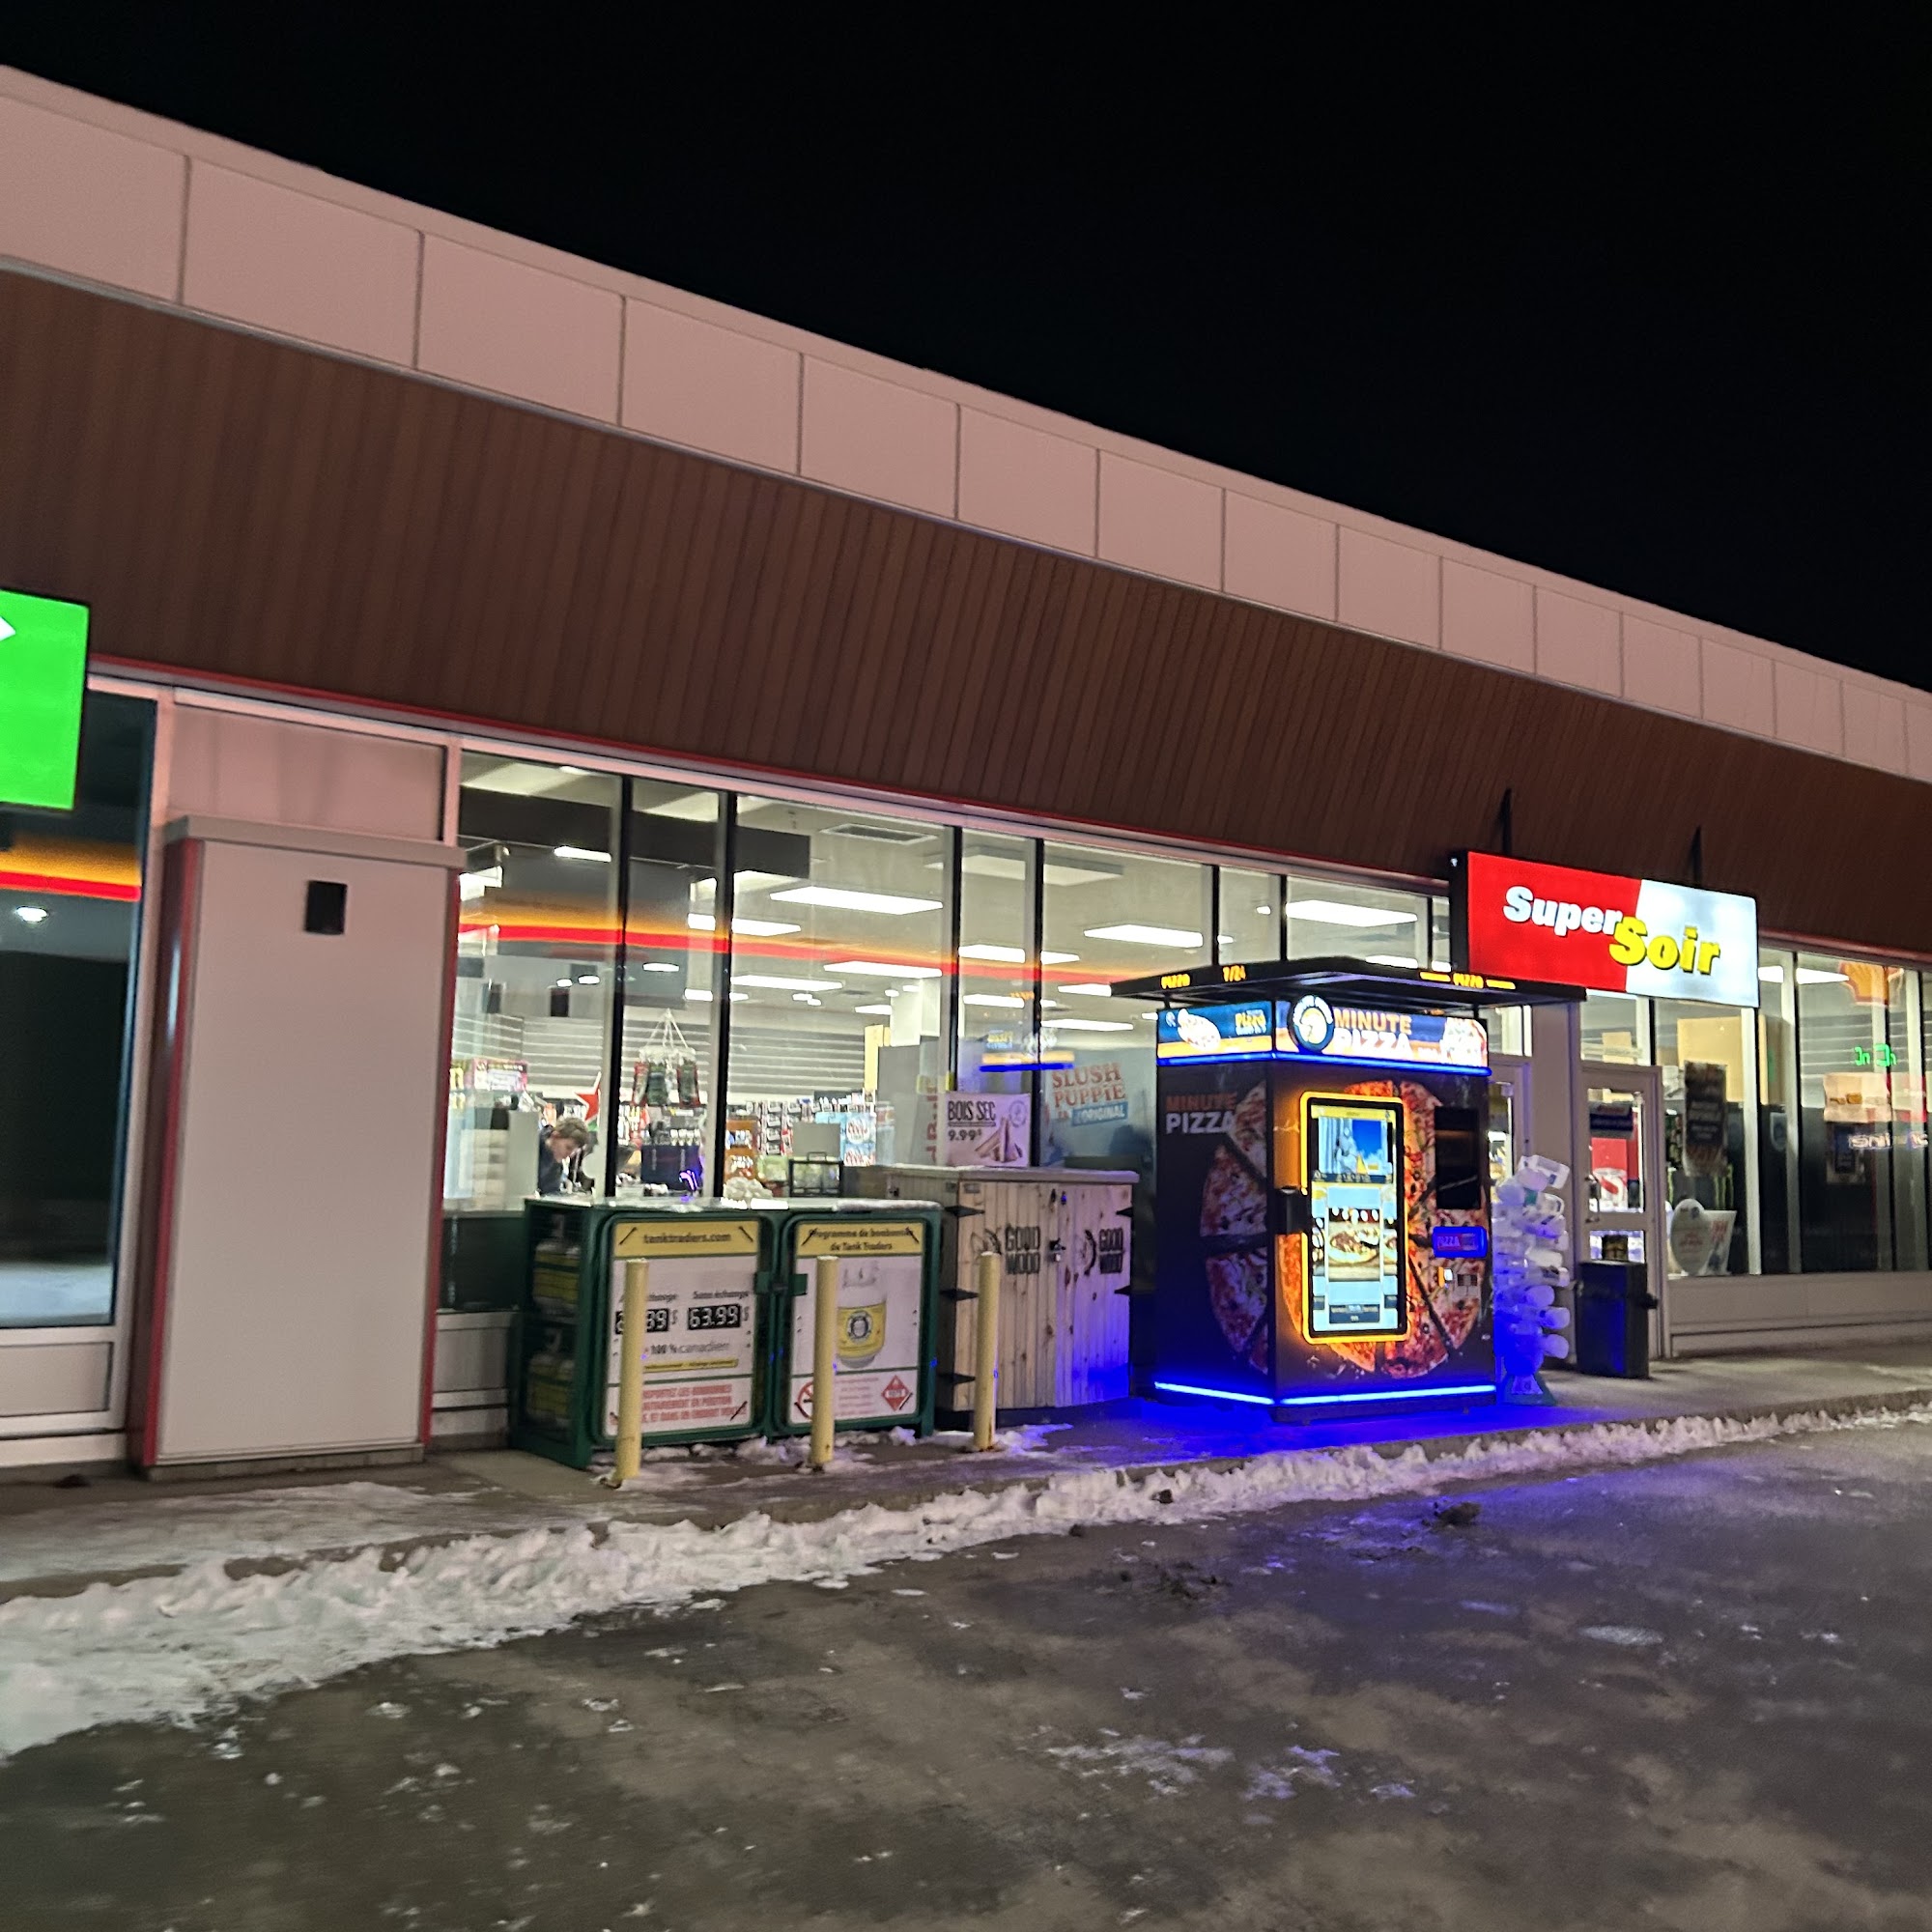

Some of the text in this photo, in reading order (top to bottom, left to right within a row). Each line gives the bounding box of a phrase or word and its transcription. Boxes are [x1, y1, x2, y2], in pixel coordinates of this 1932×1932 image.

[1503, 886, 1720, 975] Super Soir
[1334, 1008, 1411, 1035] MINUTE
[1334, 1028, 1412, 1059] PIZZA
[1052, 1064, 1122, 1088] SLUSH
[948, 1100, 996, 1121] BOIS SEC
[1166, 1093, 1237, 1111] MINUTE
[1166, 1111, 1236, 1134] PIZZA
[643, 1233, 731, 1244] tanktraders.com
[842, 1241, 861, 1250] Tank
[689, 1305, 738, 1327] 63.99
